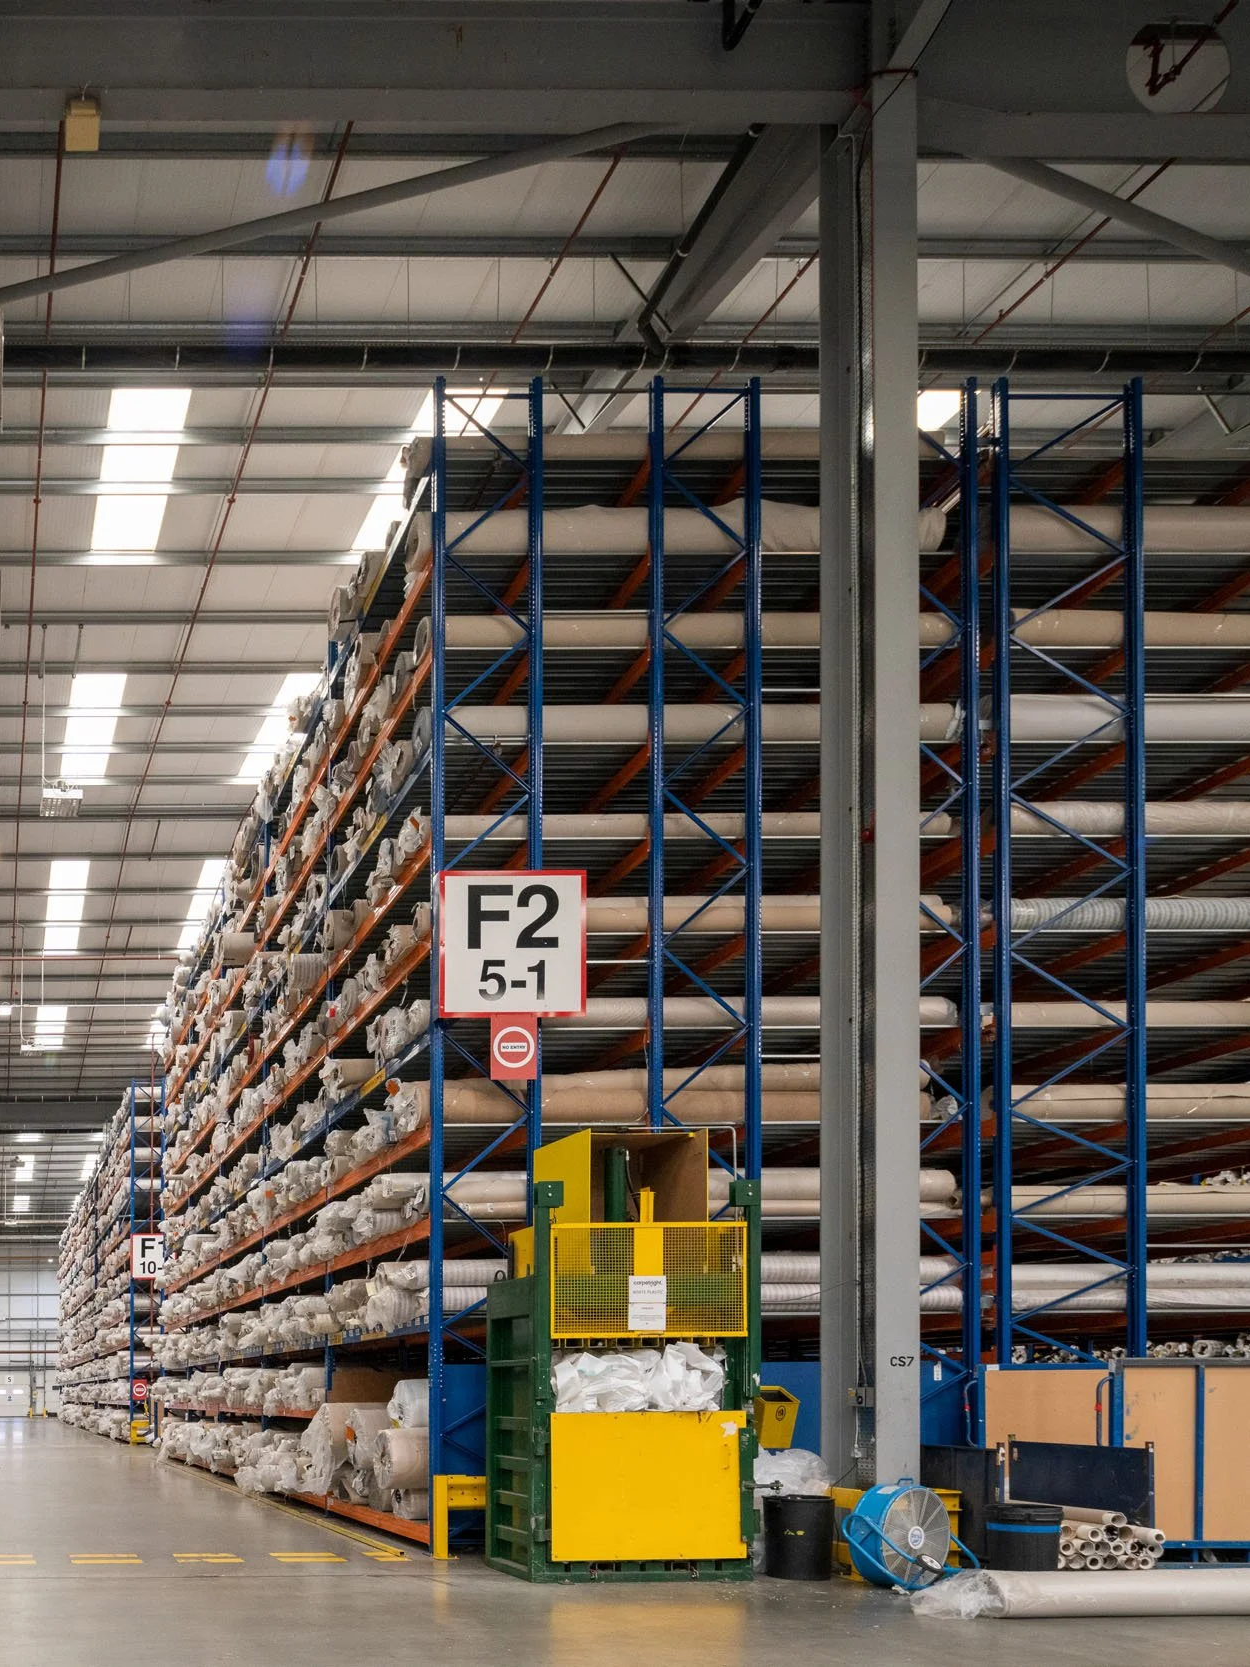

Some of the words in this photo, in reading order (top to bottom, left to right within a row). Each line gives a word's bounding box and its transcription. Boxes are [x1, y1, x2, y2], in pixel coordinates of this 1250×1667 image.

[467, 884, 560, 950] F2
[478, 959, 546, 1002] 5-1
[890, 1356, 915, 1367] CS7
